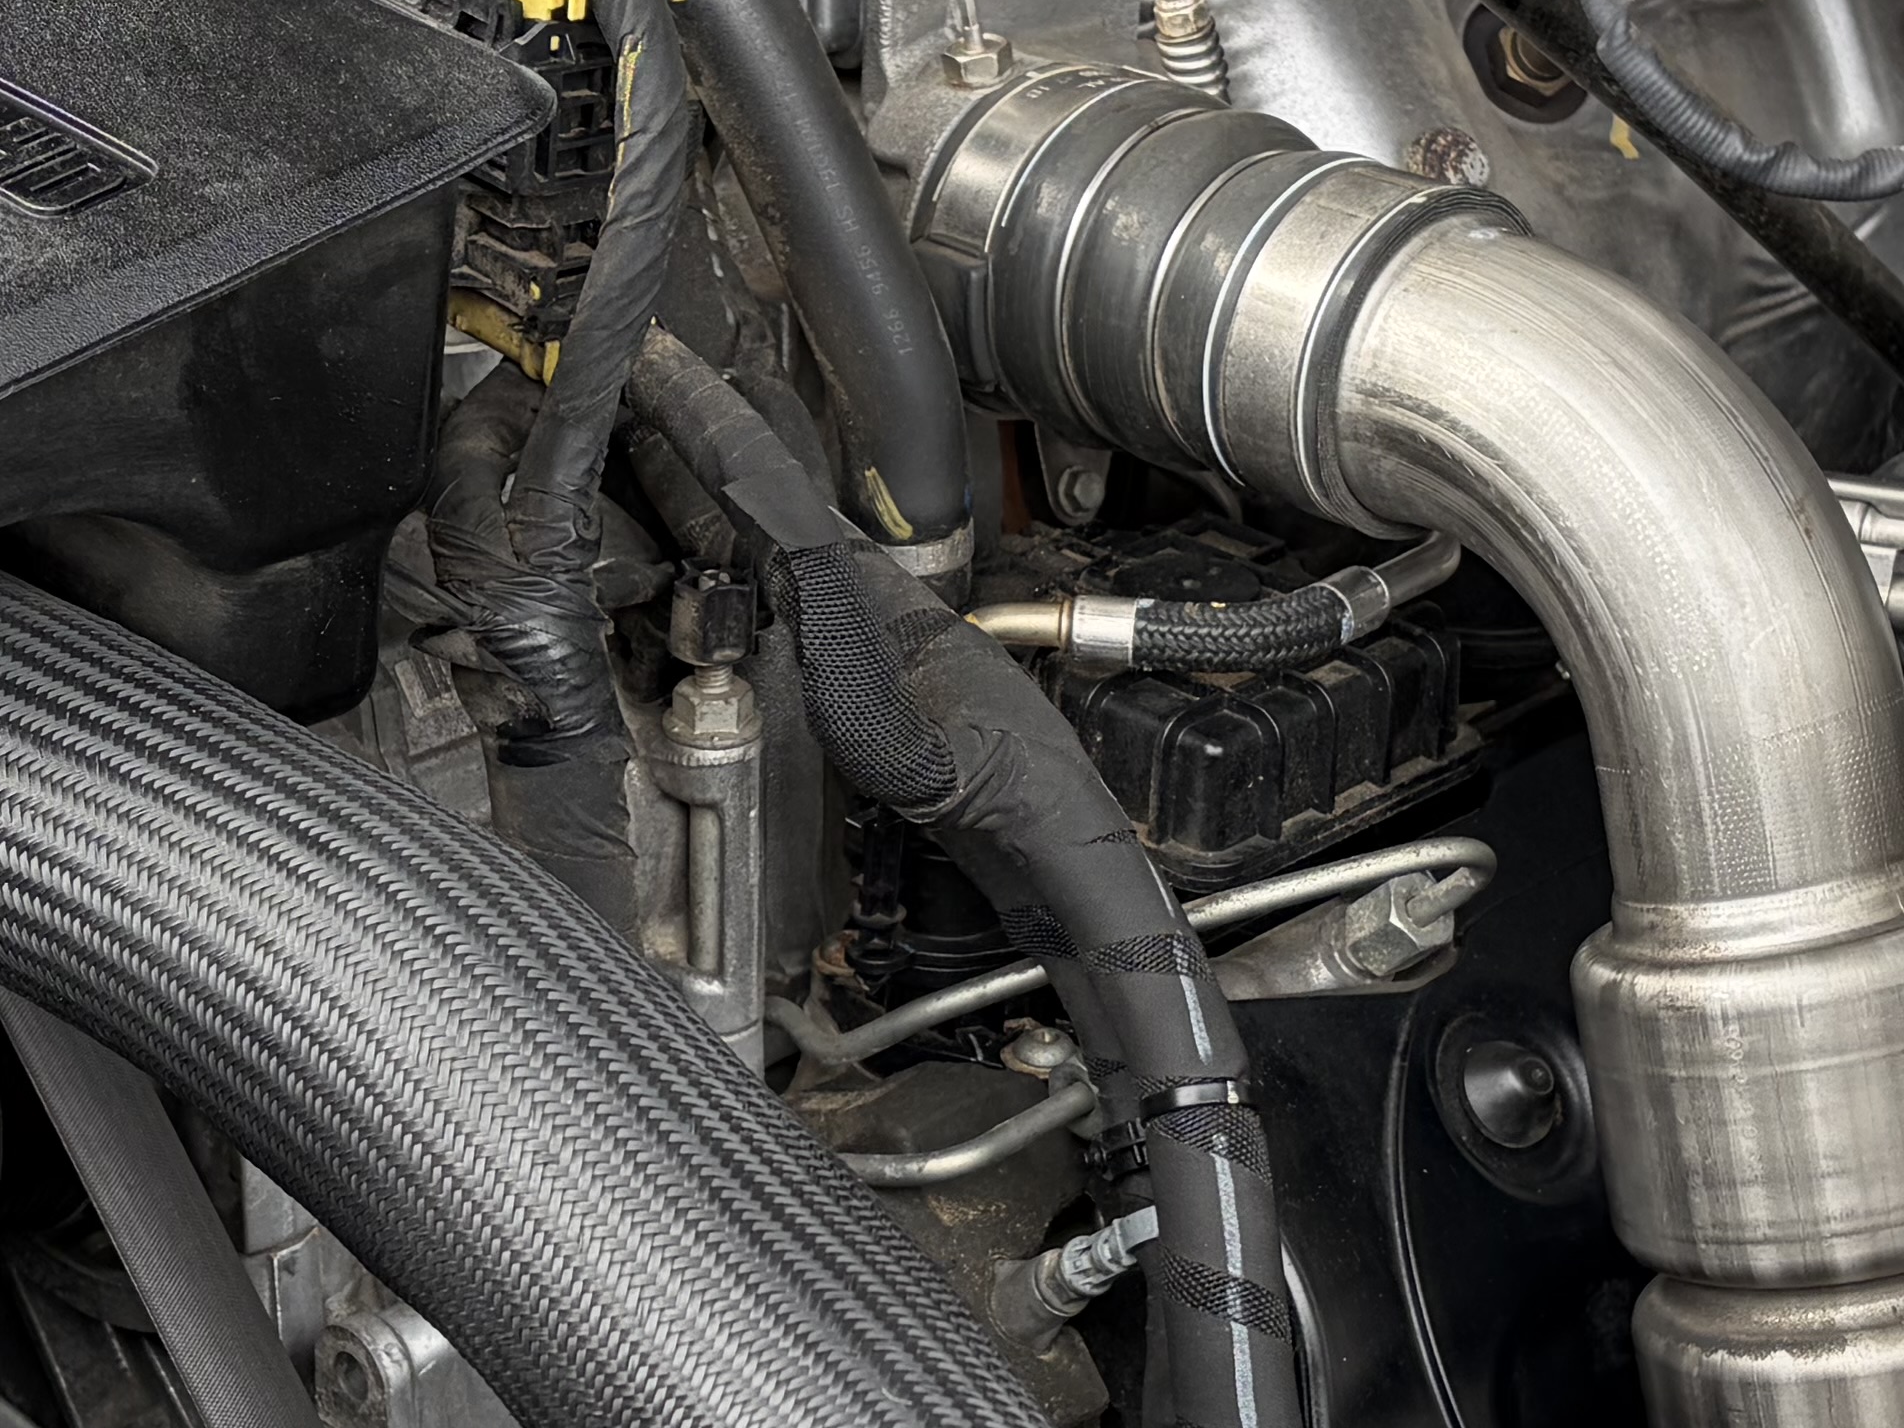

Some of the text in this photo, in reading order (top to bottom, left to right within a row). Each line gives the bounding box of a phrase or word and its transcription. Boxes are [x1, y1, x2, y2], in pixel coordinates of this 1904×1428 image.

[836, 204, 862, 233] HS
[855, 244, 887, 296] 9456
[882, 310, 914, 357] 1266
